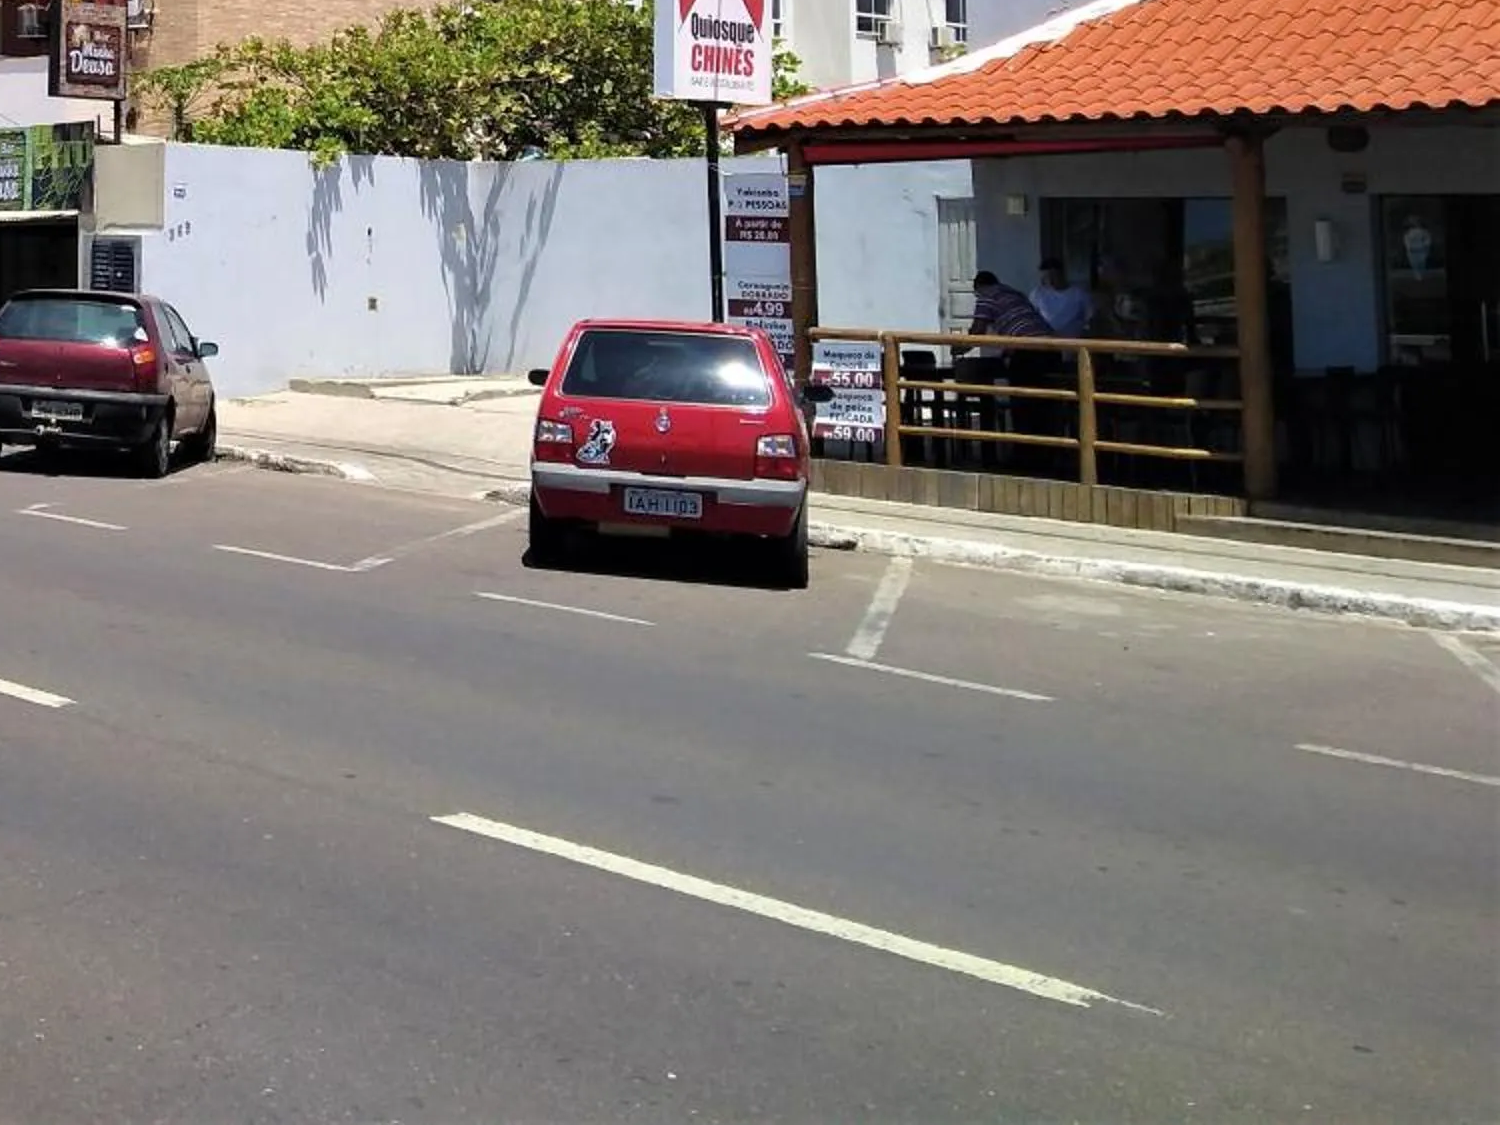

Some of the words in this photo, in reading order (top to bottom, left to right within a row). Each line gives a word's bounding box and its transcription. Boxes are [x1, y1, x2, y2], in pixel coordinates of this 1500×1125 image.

[691, 12, 754, 44] Quiosque
[70, 50, 115, 76] Deusa
[691, 43, 754, 76] CHINÊS
[745, 200, 787, 210] PESSOAS
